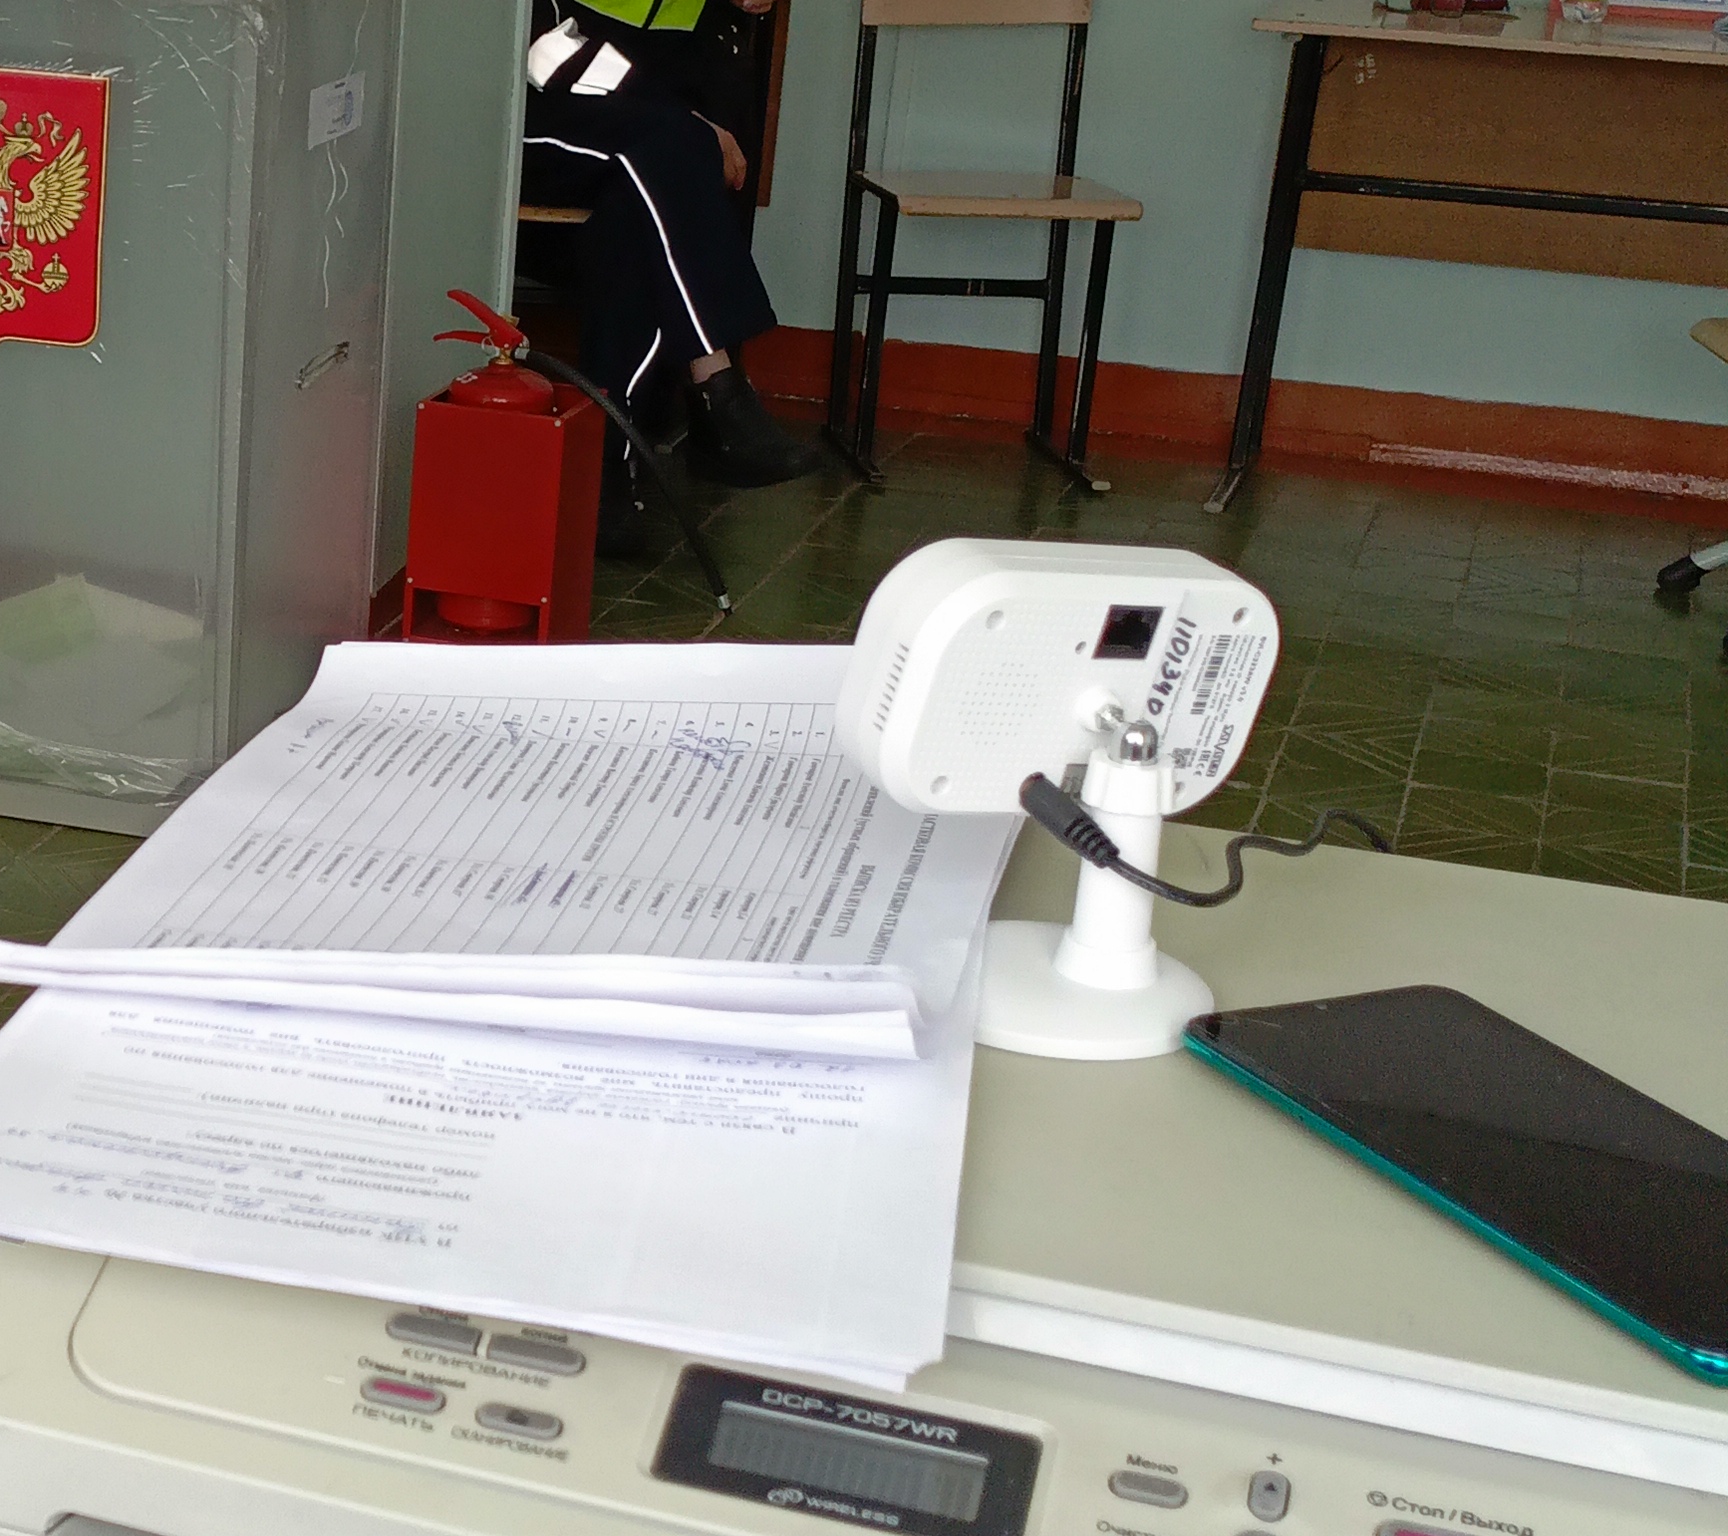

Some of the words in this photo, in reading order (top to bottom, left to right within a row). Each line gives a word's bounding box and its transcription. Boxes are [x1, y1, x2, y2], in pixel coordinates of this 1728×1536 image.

[402, 1347, 550, 1388] КОПИРОВАНИЕ
[352, 1402, 434, 1433] ПЕЧАТЬ
[761, 1388, 958, 1443] DCP-7057WR
[451, 1425, 570, 1462] СКАНИРОВАНИЕ
[1125, 1453, 1179, 1476] Меню
[804, 1495, 901, 1527] WIRELESS
[1391, 1496, 1446, 1521] Стоп
